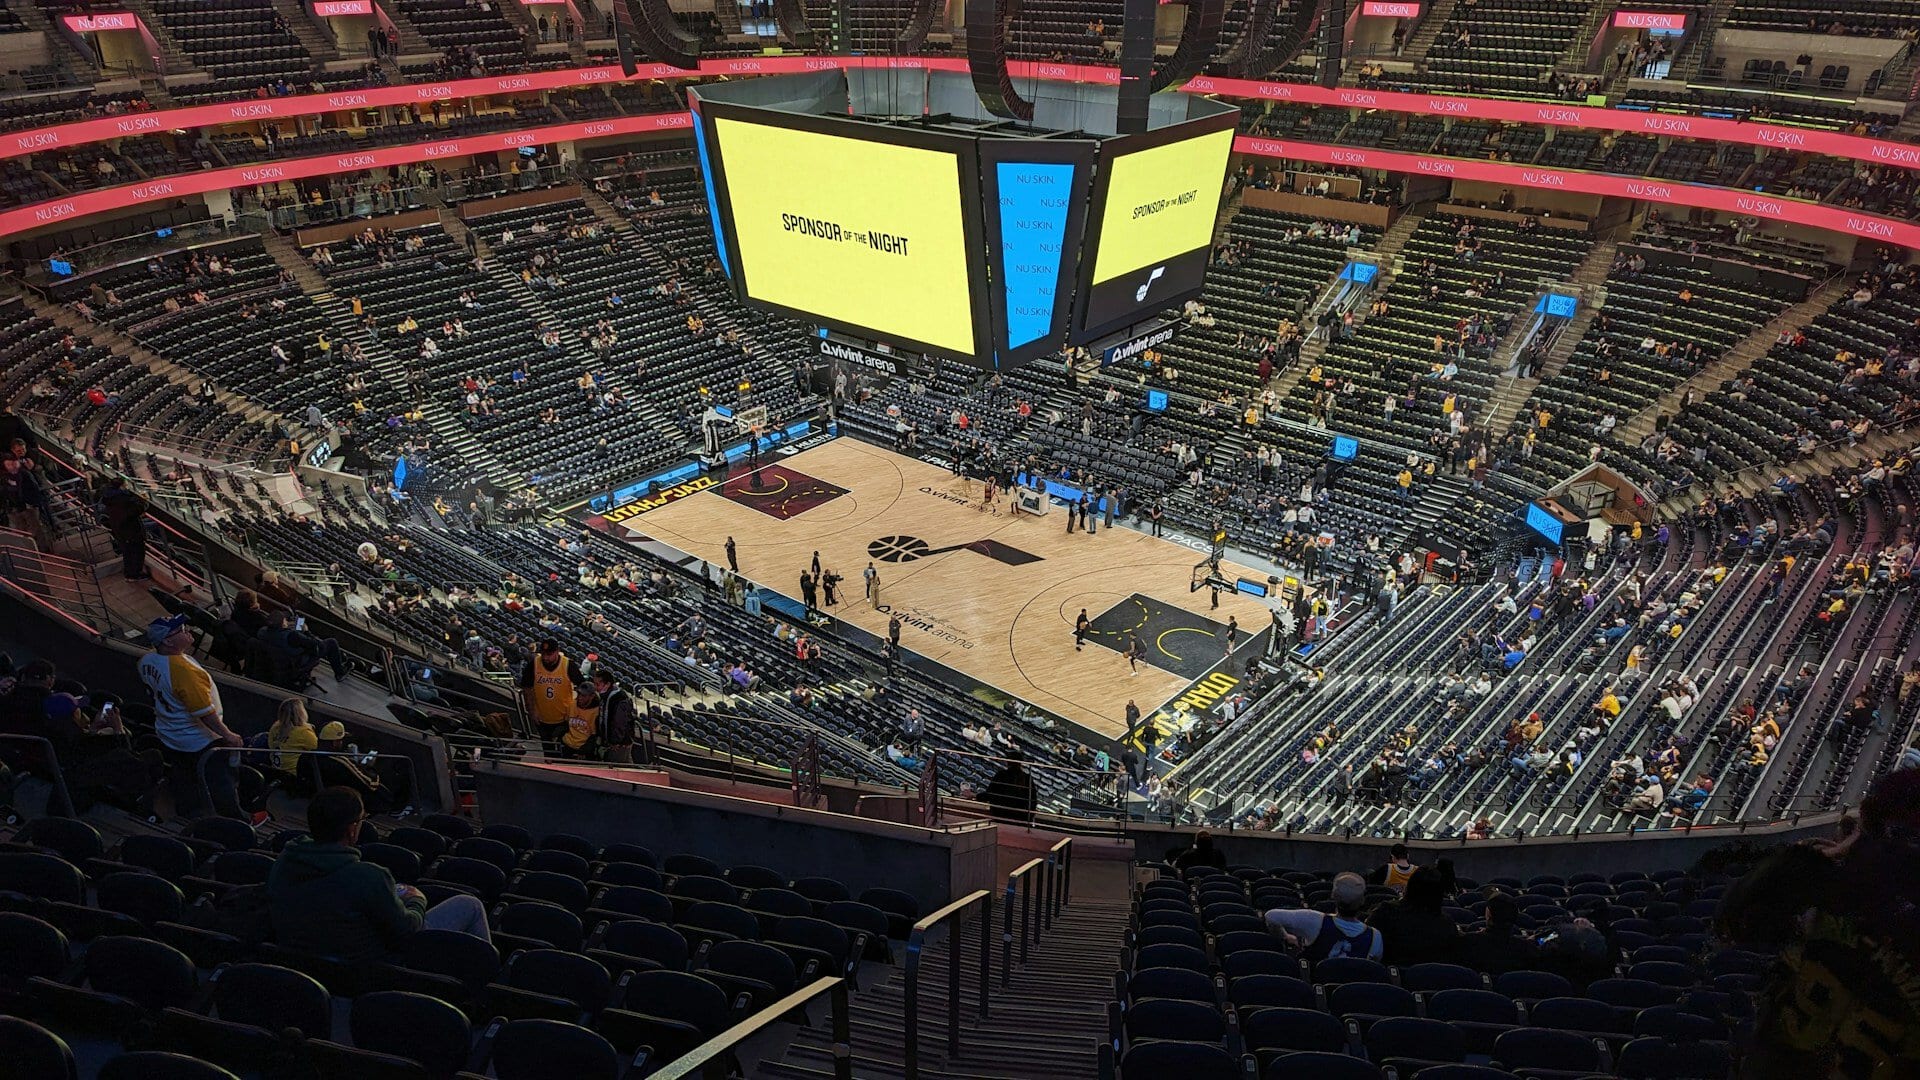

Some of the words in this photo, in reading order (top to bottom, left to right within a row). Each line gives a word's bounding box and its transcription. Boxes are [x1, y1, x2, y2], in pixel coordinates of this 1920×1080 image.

[325, 4, 339, 14] NU
[341, 2, 363, 13] SKIN
[1373, 5, 1387, 15] NU
[1389, 4, 1409, 15] SKIN
[78, 18, 96, 28] NU
[98, 17, 123, 29] SKIN
[1628, 16, 1644, 25] NU
[1646, 16, 1671, 27] SKIN
[580, 72, 592, 80] NU
[593, 71, 609, 79] SKIN
[499, 80, 510, 89] NU
[512, 79, 529, 88] SKIN
[418, 89, 431, 97] NU
[433, 87, 452, 96] SKIN
[1260, 86, 1272, 95] NU
[1273, 87, 1291, 96] SKIN
[329, 97, 343, 106] NU
[345, 95, 366, 105] SKIN
[1341, 93, 1354, 102] NU
[1356, 94, 1376, 104] SKIN
[231, 107, 247, 117] NU
[249, 104, 272, 115] SKIN
[1430, 101, 1444, 110] NU
[1446, 102, 1468, 112] SKIN
[1538, 109, 1554, 119] NU
[1556, 111, 1580, 121] SKIN
[118, 120, 134, 132] NU
[135, 117, 159, 129] SKIN
[657, 118, 668, 126] NU
[669, 117, 686, 125] SKIN
[1645, 118, 1662, 128] NU
[1664, 120, 1689, 132] SKIN
[585, 126, 596, 134] NU
[597, 124, 613, 133] SKIN
[18, 137, 34, 148] NU
[35, 132, 59, 146] SKIN
[517, 134, 534, 143] SKIN
[1758, 130, 1776, 141] NU
[1777, 132, 1804, 145] SKIN
[425, 146, 438, 155] NU
[440, 144, 458, 154] SKIN
[1251, 142, 1264, 151] NU
[1264, 143, 1283, 153] SKIN
[1331, 152, 1344, 160] NU
[1347, 153, 1364, 162] SKIN
[1872, 146, 1891, 158] NU
[1892, 149, 1919, 162] SKIN
[338, 158, 352, 167] NU
[354, 156, 374, 166] SKIN
[1418, 161, 1432, 170] NU
[1434, 163, 1454, 173] SKIN
[243, 171, 258, 180] NU
[260, 167, 282, 178] SKIN
[1017, 175, 1031, 184] NU
[1034, 175, 1054, 184] SKIN
[1523, 173, 1538, 182] NU
[1540, 174, 1563, 185] SKIN
[132, 188, 147, 199] NU
[149, 184, 172, 196] SKIN
[1627, 184, 1644, 194] NU
[1646, 186, 1670, 197] SKIN
[1040, 199, 1054, 207] NU
[1132, 199, 1165, 220] SPONSOR
[1177, 189, 1198, 206] NIGHT
[1737, 198, 1754, 209] NU
[1756, 202, 1781, 214] SKIN
[36, 208, 51, 220] NU
[53, 203, 75, 216] SKIN
[1017, 220, 1030, 229] NU
[1032, 221, 1052, 229] SKIN
[1847, 219, 1865, 230] NU
[1867, 222, 1893, 236] SKIN
[782, 213, 842, 242] SPONSOR
[843, 230, 852, 240] OF
[853, 232, 867, 244] THE
[868, 230, 908, 256] NIGHT
[1040, 244, 1053, 252] NU
[1016, 264, 1029, 273] NU
[1031, 265, 1051, 273] SKIN
[1038, 287, 1052, 295] NU
[1016, 307, 1028, 315] NU
[1031, 307, 1050, 316] SKIN
[1122, 336, 1149, 359] vivint
[1148, 328, 1173, 347] arena
[831, 344, 864, 365] vivint
[864, 355, 897, 374] arena
[602, 499, 658, 523] UTAH
[672, 475, 720, 499] JAZZ
[1168, 534, 1214, 552] PACS
[892, 611, 934, 632] vivint
[932, 629, 975, 649] arena
[546, 686, 554, 699] 6
[1180, 672, 1240, 709] UTAH
